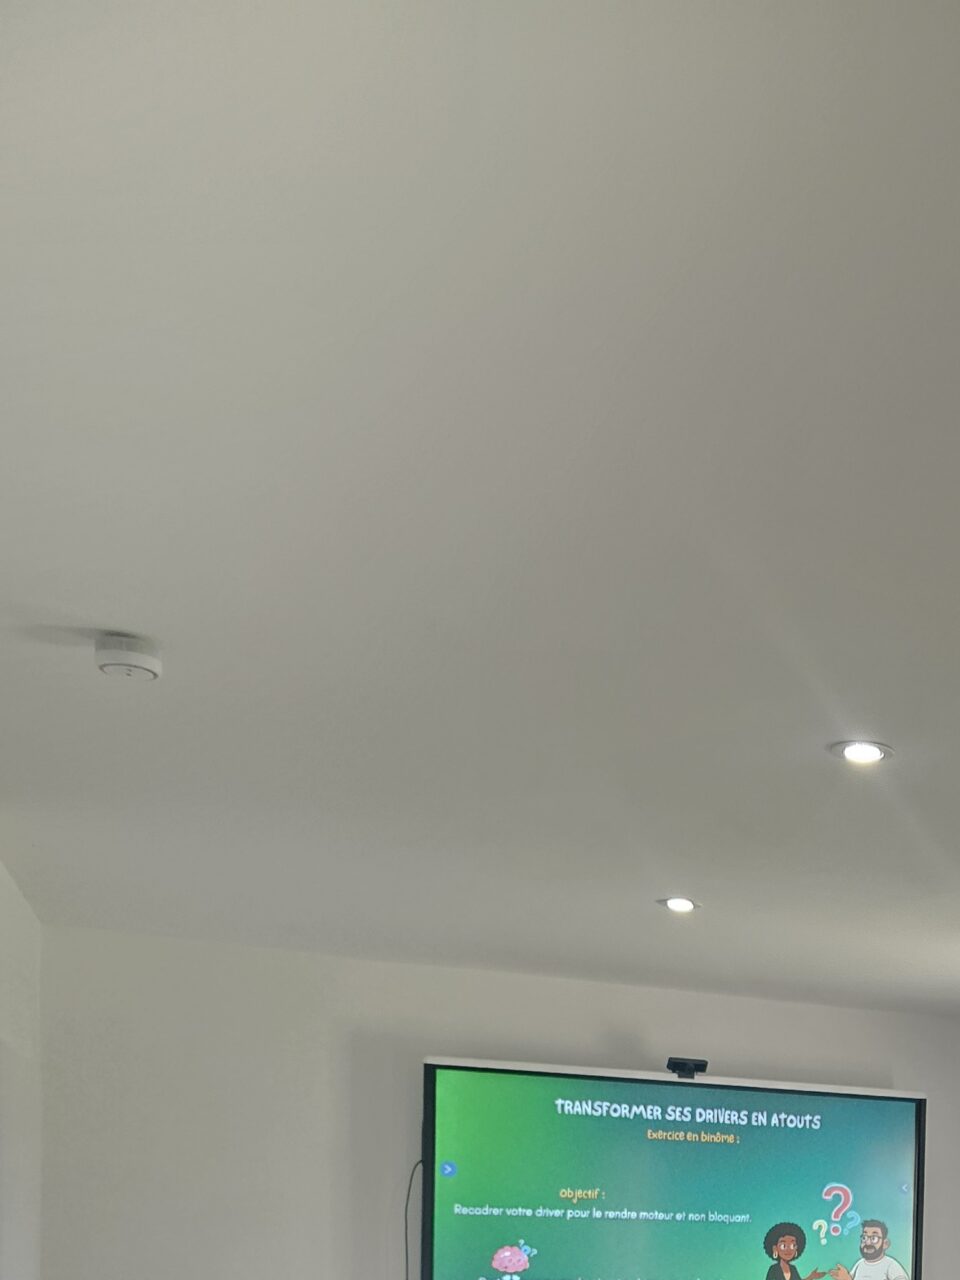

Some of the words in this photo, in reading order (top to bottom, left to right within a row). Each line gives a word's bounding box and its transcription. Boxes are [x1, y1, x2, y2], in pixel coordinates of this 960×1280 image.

[554, 1098, 662, 1120] TRANSFORMER
[665, 1105, 692, 1122] SES
[695, 1107, 749, 1126] DRIVERS
[751, 1110, 767, 1126] EN
[770, 1111, 821, 1129] ATOUTS
[647, 1129, 685, 1141] Exercice
[686, 1131, 699, 1141] en
[700, 1130, 735, 1143] binôme
[454, 1203, 503, 1216] Recadrer
[505, 1206, 533, 1217] votre
[535, 1205, 564, 1218] driver
[566, 1208, 590, 1220] pour
[592, 1207, 602, 1219] le
[604, 1207, 637, 1220] rendre
[639, 1210, 674, 1221] moteur
[675, 1211, 686, 1221] et
[688, 1212, 706, 1222] non
